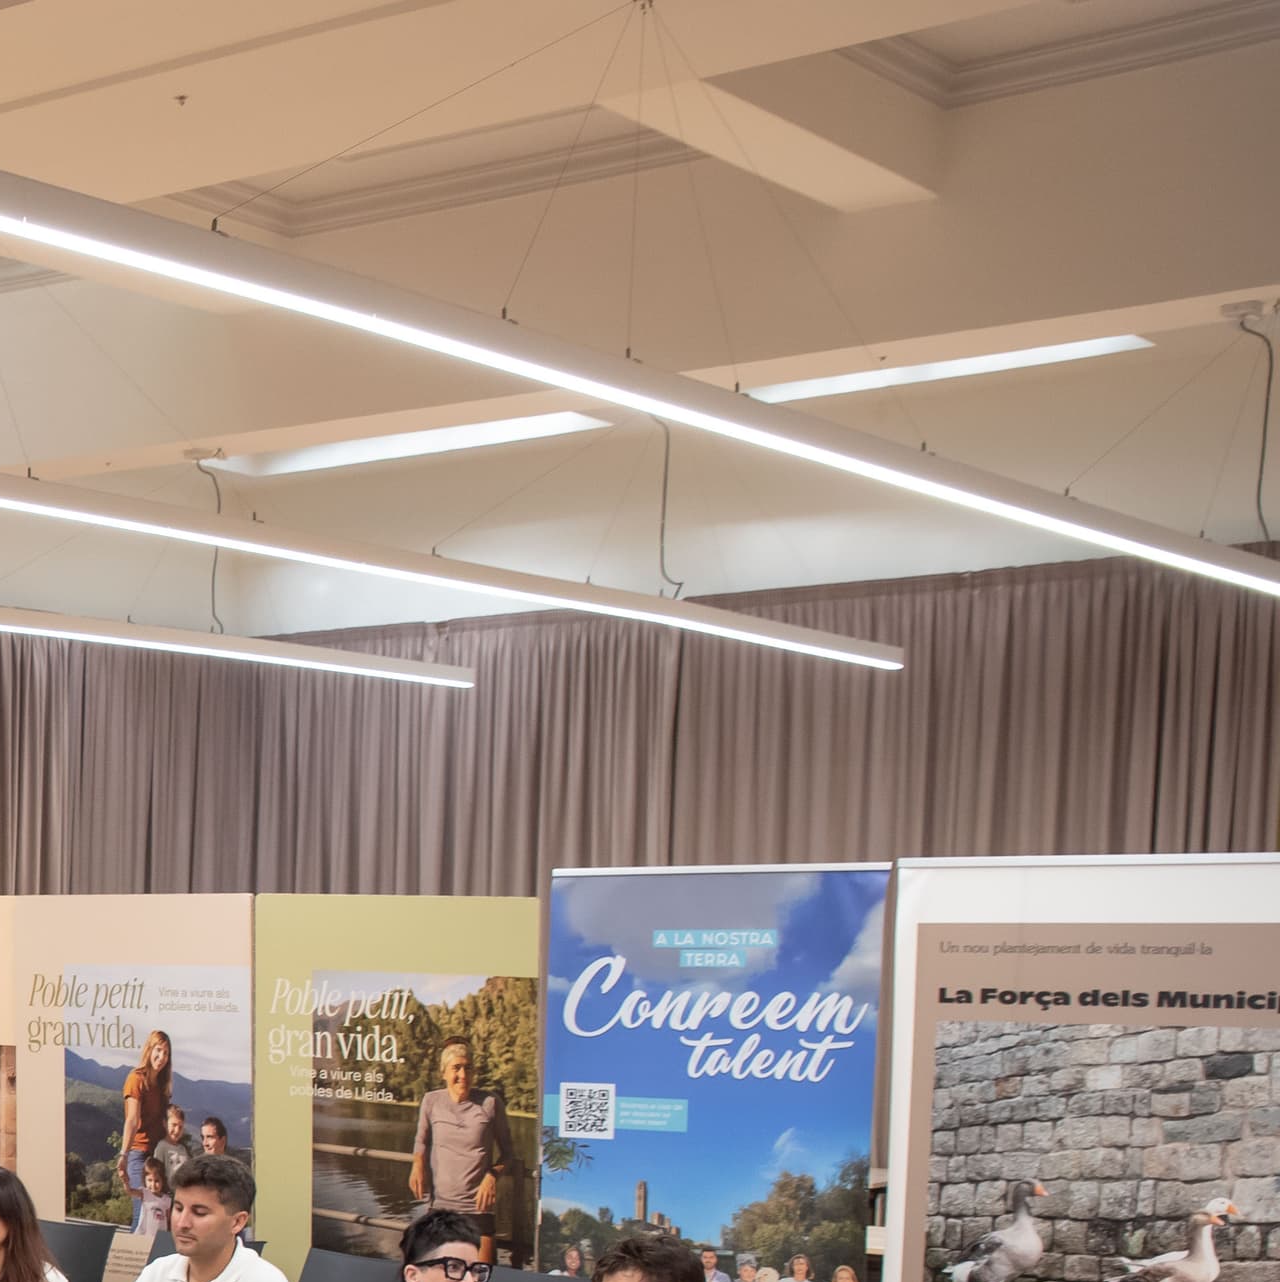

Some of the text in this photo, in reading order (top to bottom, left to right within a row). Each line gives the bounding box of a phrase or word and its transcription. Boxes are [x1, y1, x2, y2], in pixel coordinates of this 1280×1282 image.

[655, 931, 774, 945] A LA NOSTRA
[939, 941, 959, 953] Un
[962, 944, 989, 954] nou
[1085, 941, 1103, 954] de
[1107, 942, 1136, 955] vida
[684, 952, 740, 966] TERRA
[29, 974, 149, 1016] Poble petit,
[158, 986, 179, 998] Vine
[269, 978, 416, 1027] Poble petit,
[562, 954, 869, 1038] Conreem
[938, 987, 1280, 1014] La Força dels Munici
[158, 1001, 192, 1013] pobles
[194, 1002, 207, 1012] de
[28, 1015, 142, 1053] gran vida.
[268, 1024, 406, 1064] gran vida.
[679, 1032, 855, 1082] talent
[290, 1065, 384, 1083] Vine a viure als
[290, 1083, 333, 1098] pobles
[335, 1085, 353, 1098] de
